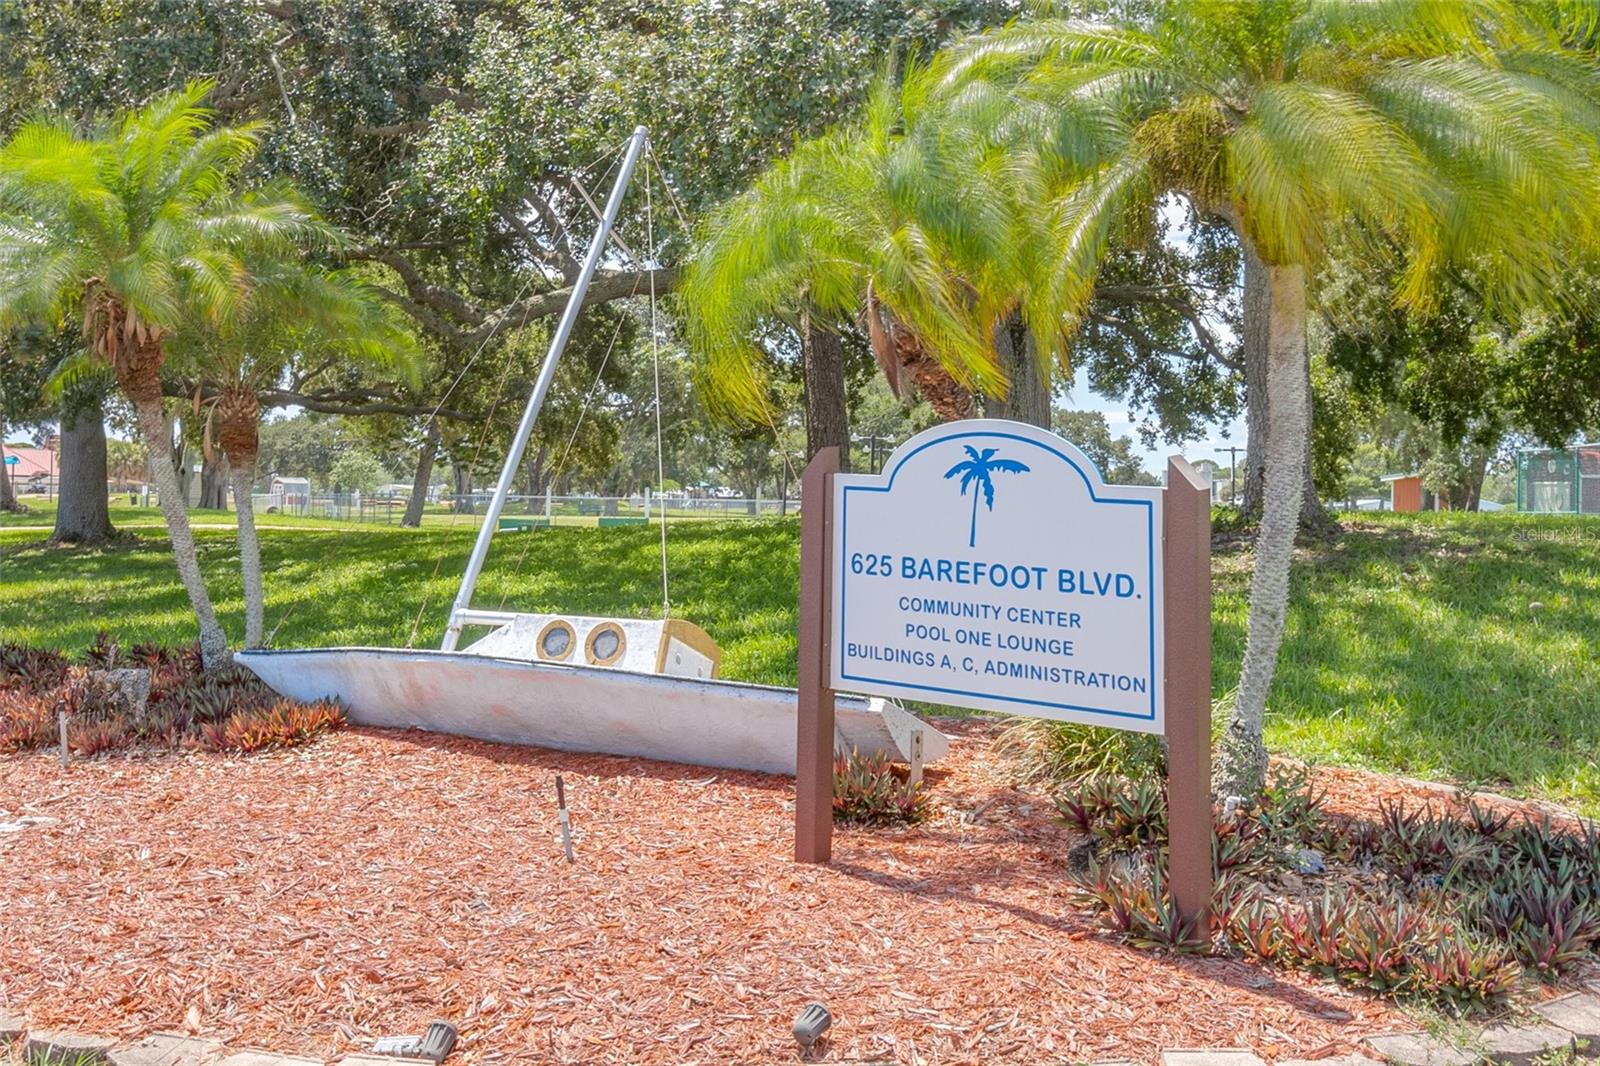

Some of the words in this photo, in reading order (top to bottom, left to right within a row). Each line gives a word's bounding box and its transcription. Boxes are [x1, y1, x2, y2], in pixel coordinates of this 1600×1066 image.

[851, 553, 893, 577] 625
[901, 556, 1048, 591] BAREFOOT
[1058, 569, 1142, 599] BLVD.
[899, 596, 1001, 621] COMMUNITY
[1007, 606, 1082, 629] CENTER
[905, 623, 950, 642] POOL
[955, 629, 992, 647] ONE
[998, 633, 1074, 656] LOUNGE
[848, 643, 935, 668] BUILDINGS
[940, 654, 957, 672] A,
[962, 657, 978, 675] C,
[984, 660, 1146, 693] ADMINISTRATION
